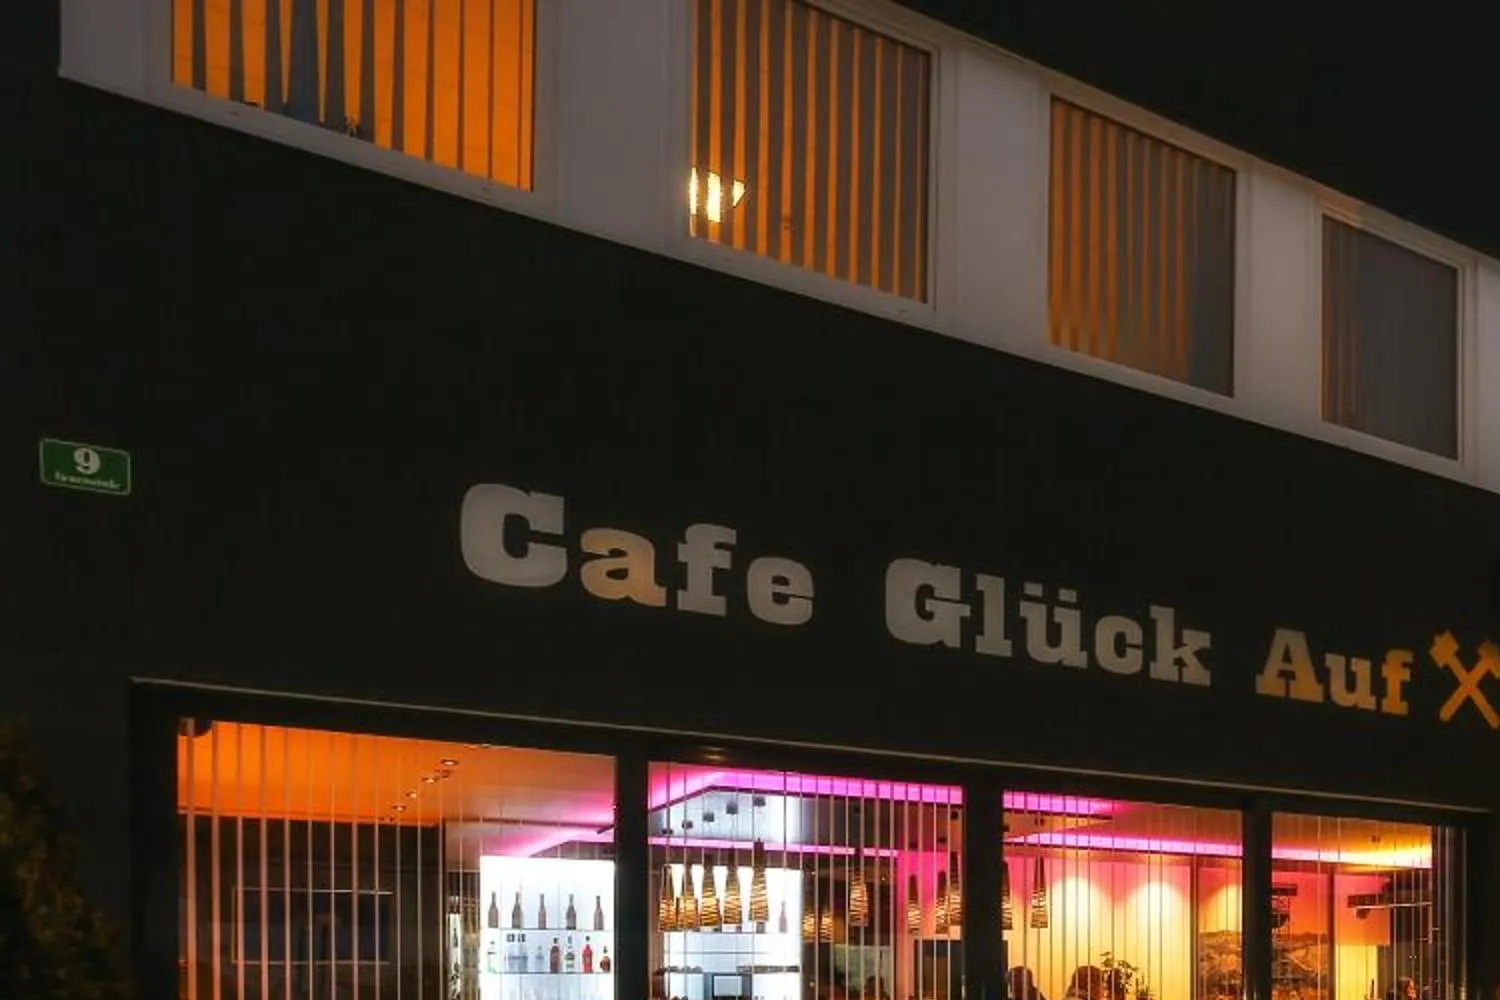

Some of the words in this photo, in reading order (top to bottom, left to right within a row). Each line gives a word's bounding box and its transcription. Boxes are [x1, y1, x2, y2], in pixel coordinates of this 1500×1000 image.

[73, 447, 101, 475] 9
[460, 483, 815, 625] Cafe
[885, 558, 1211, 686] Glück
[1255, 628, 1414, 716] Auf
